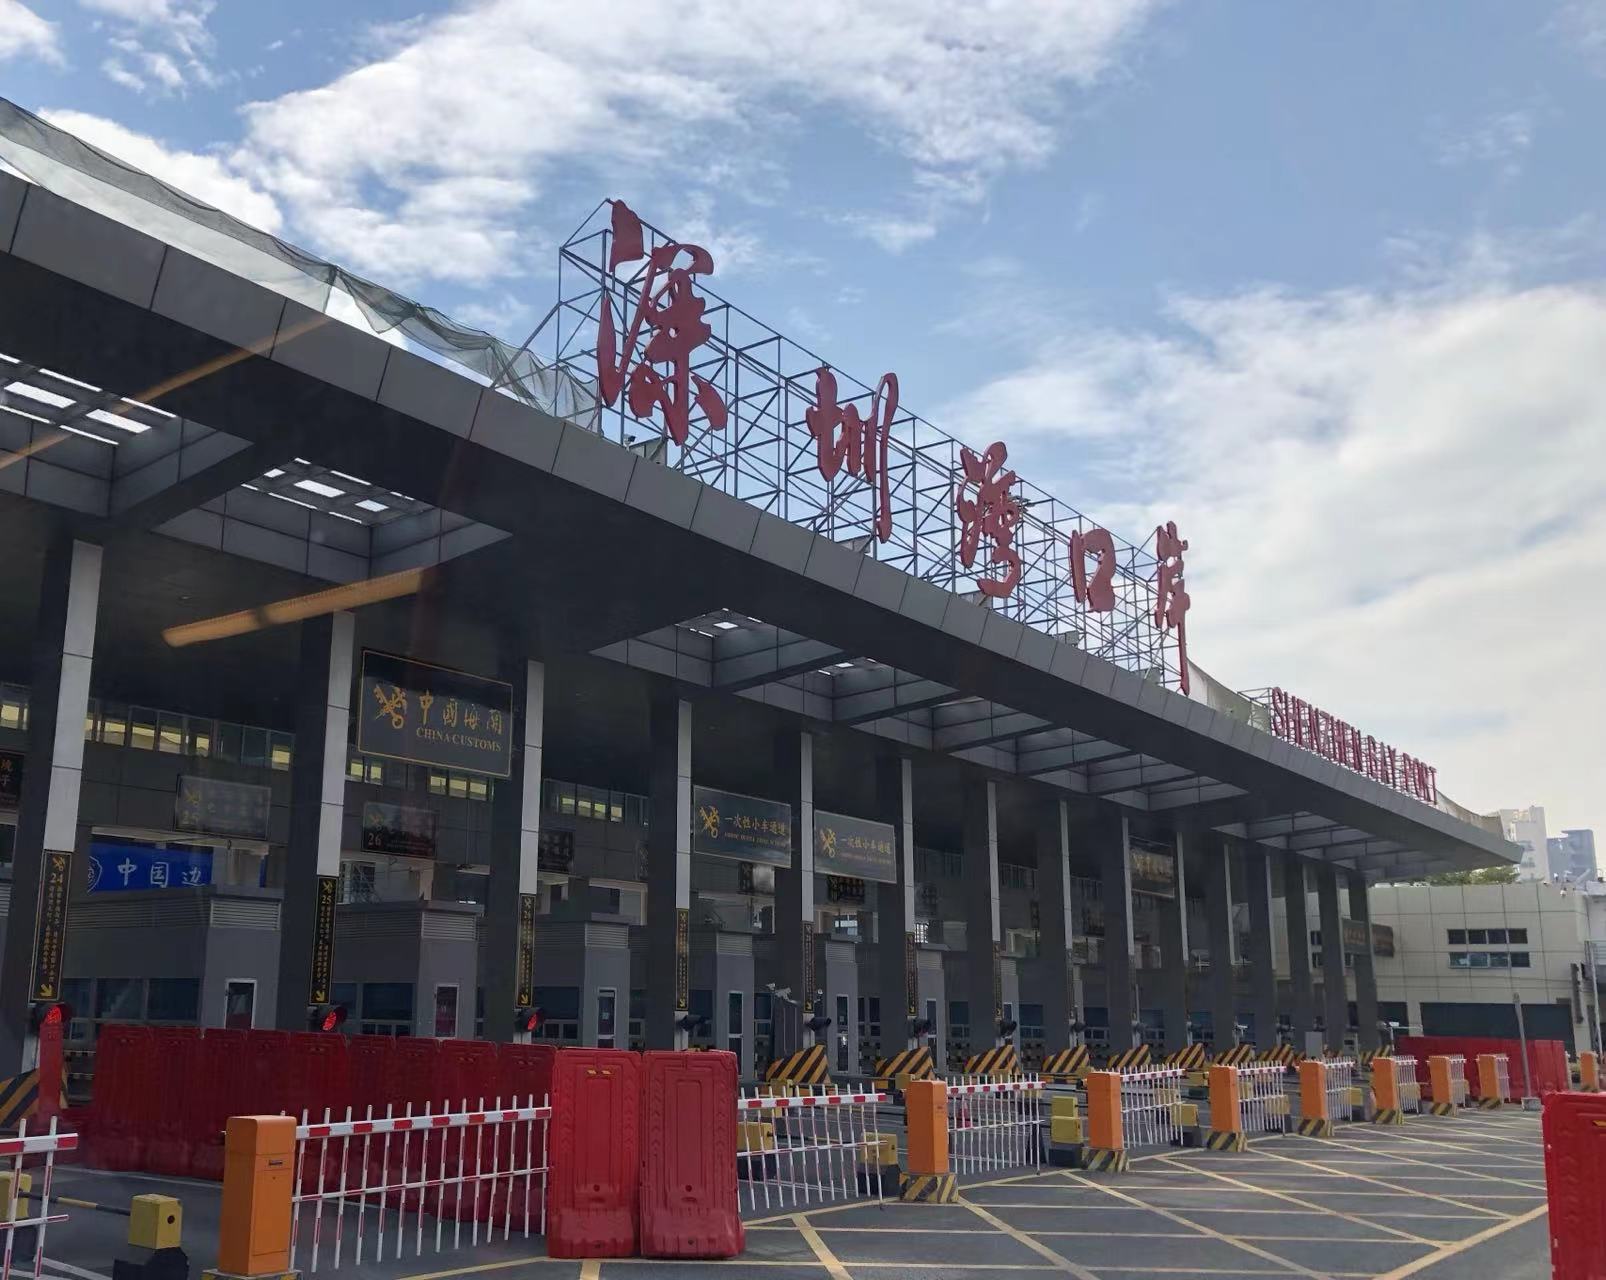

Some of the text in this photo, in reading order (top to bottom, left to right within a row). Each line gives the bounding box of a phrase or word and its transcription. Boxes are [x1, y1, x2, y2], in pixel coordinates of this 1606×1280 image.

[415, 727, 503, 752] CHINA CUSTOMS
[1272, 686, 1437, 805] SHENZHEN BAY PORT
[367, 832, 382, 846] 26
[117, 857, 208, 888] 中国边
